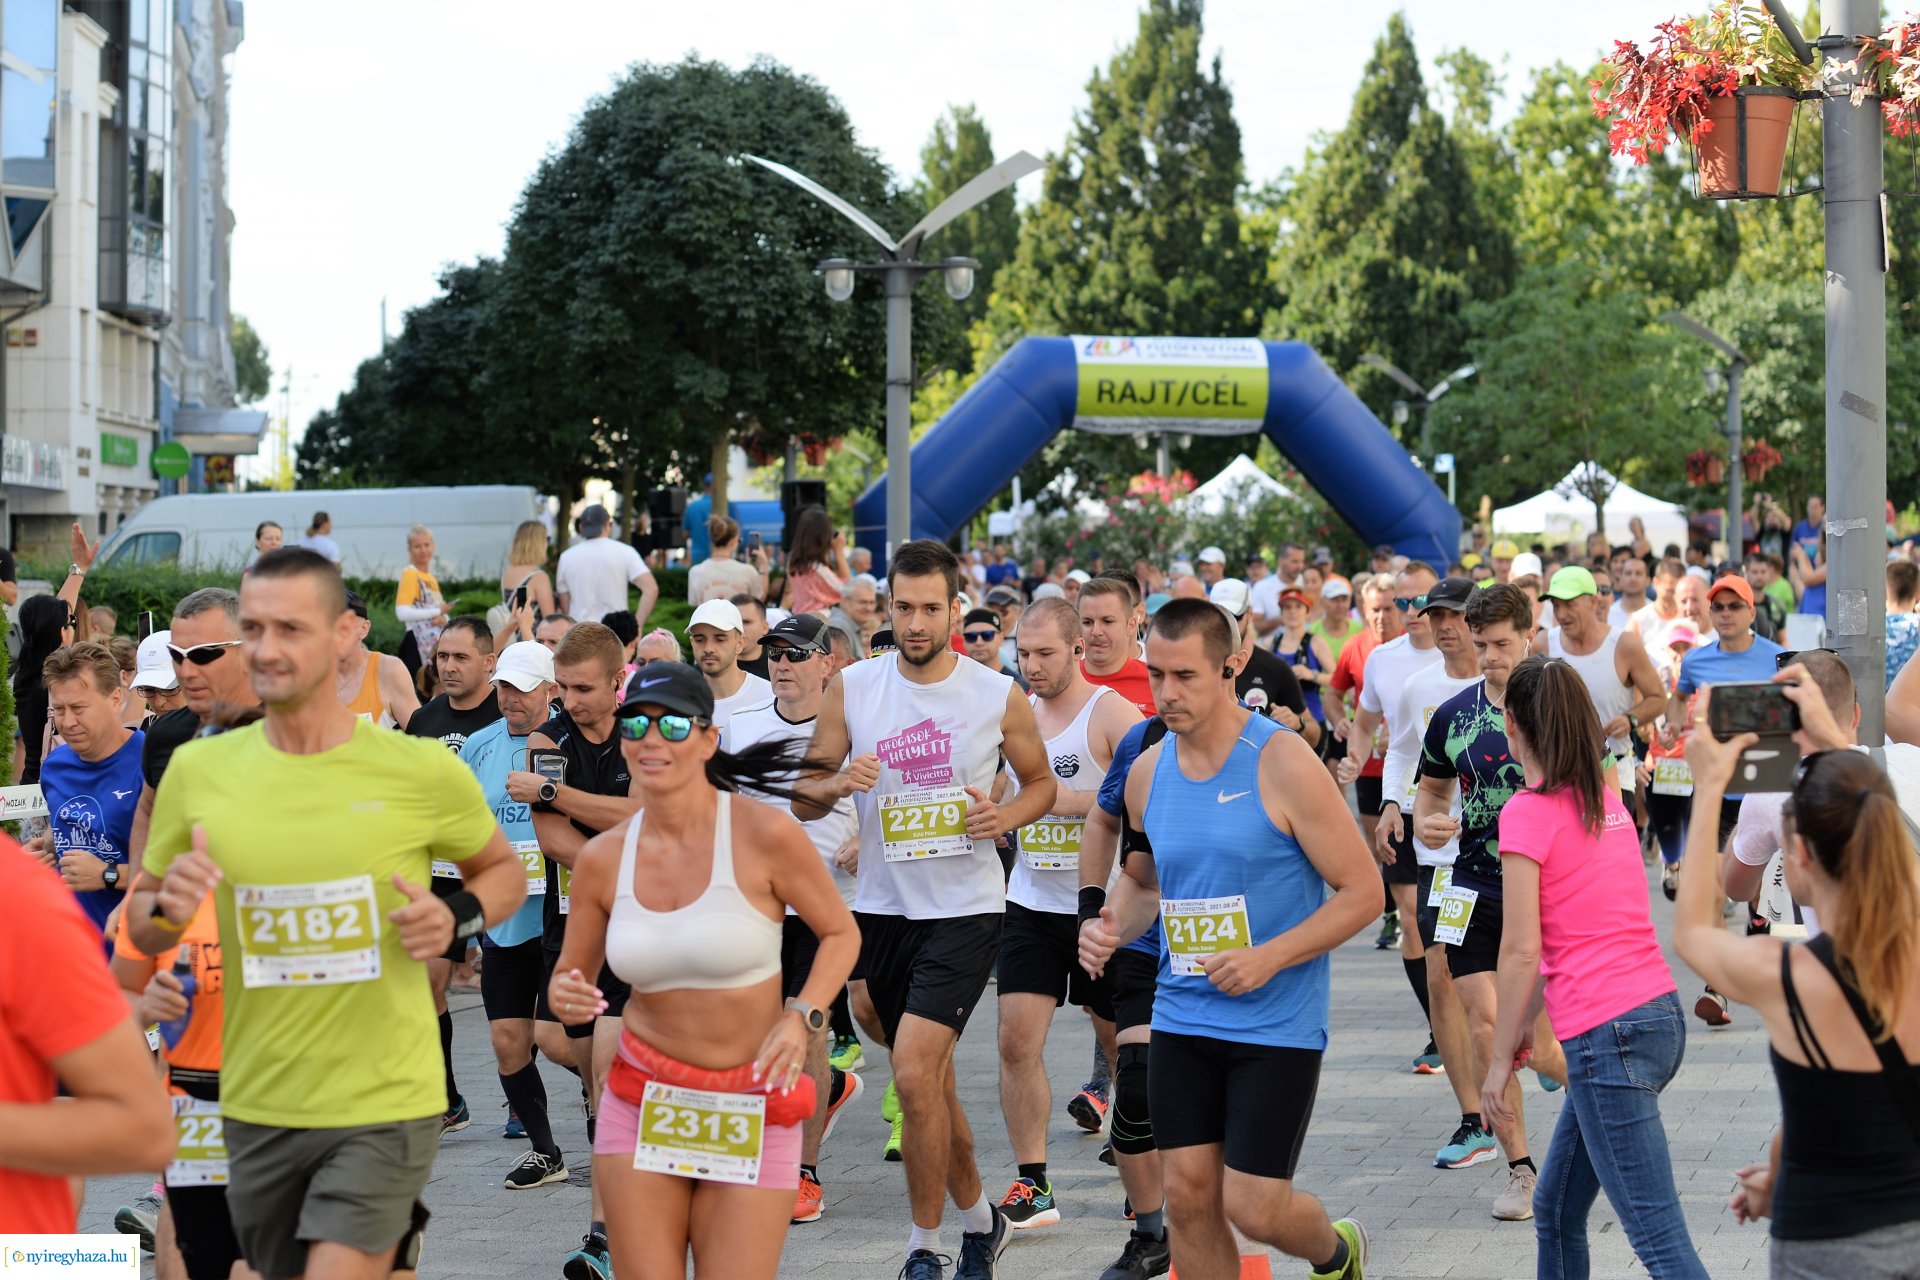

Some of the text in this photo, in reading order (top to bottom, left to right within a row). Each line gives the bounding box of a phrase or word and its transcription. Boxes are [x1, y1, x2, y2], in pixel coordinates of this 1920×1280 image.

[1097, 374, 1247, 406] RAJT/CÉL
[913, 769, 949, 781] Vivicittá
[889, 803, 960, 832] 2279
[1024, 824, 1082, 844] 2304
[251, 904, 363, 943] 2182
[1170, 915, 1238, 942] 2124
[651, 1105, 749, 1144] 2313
